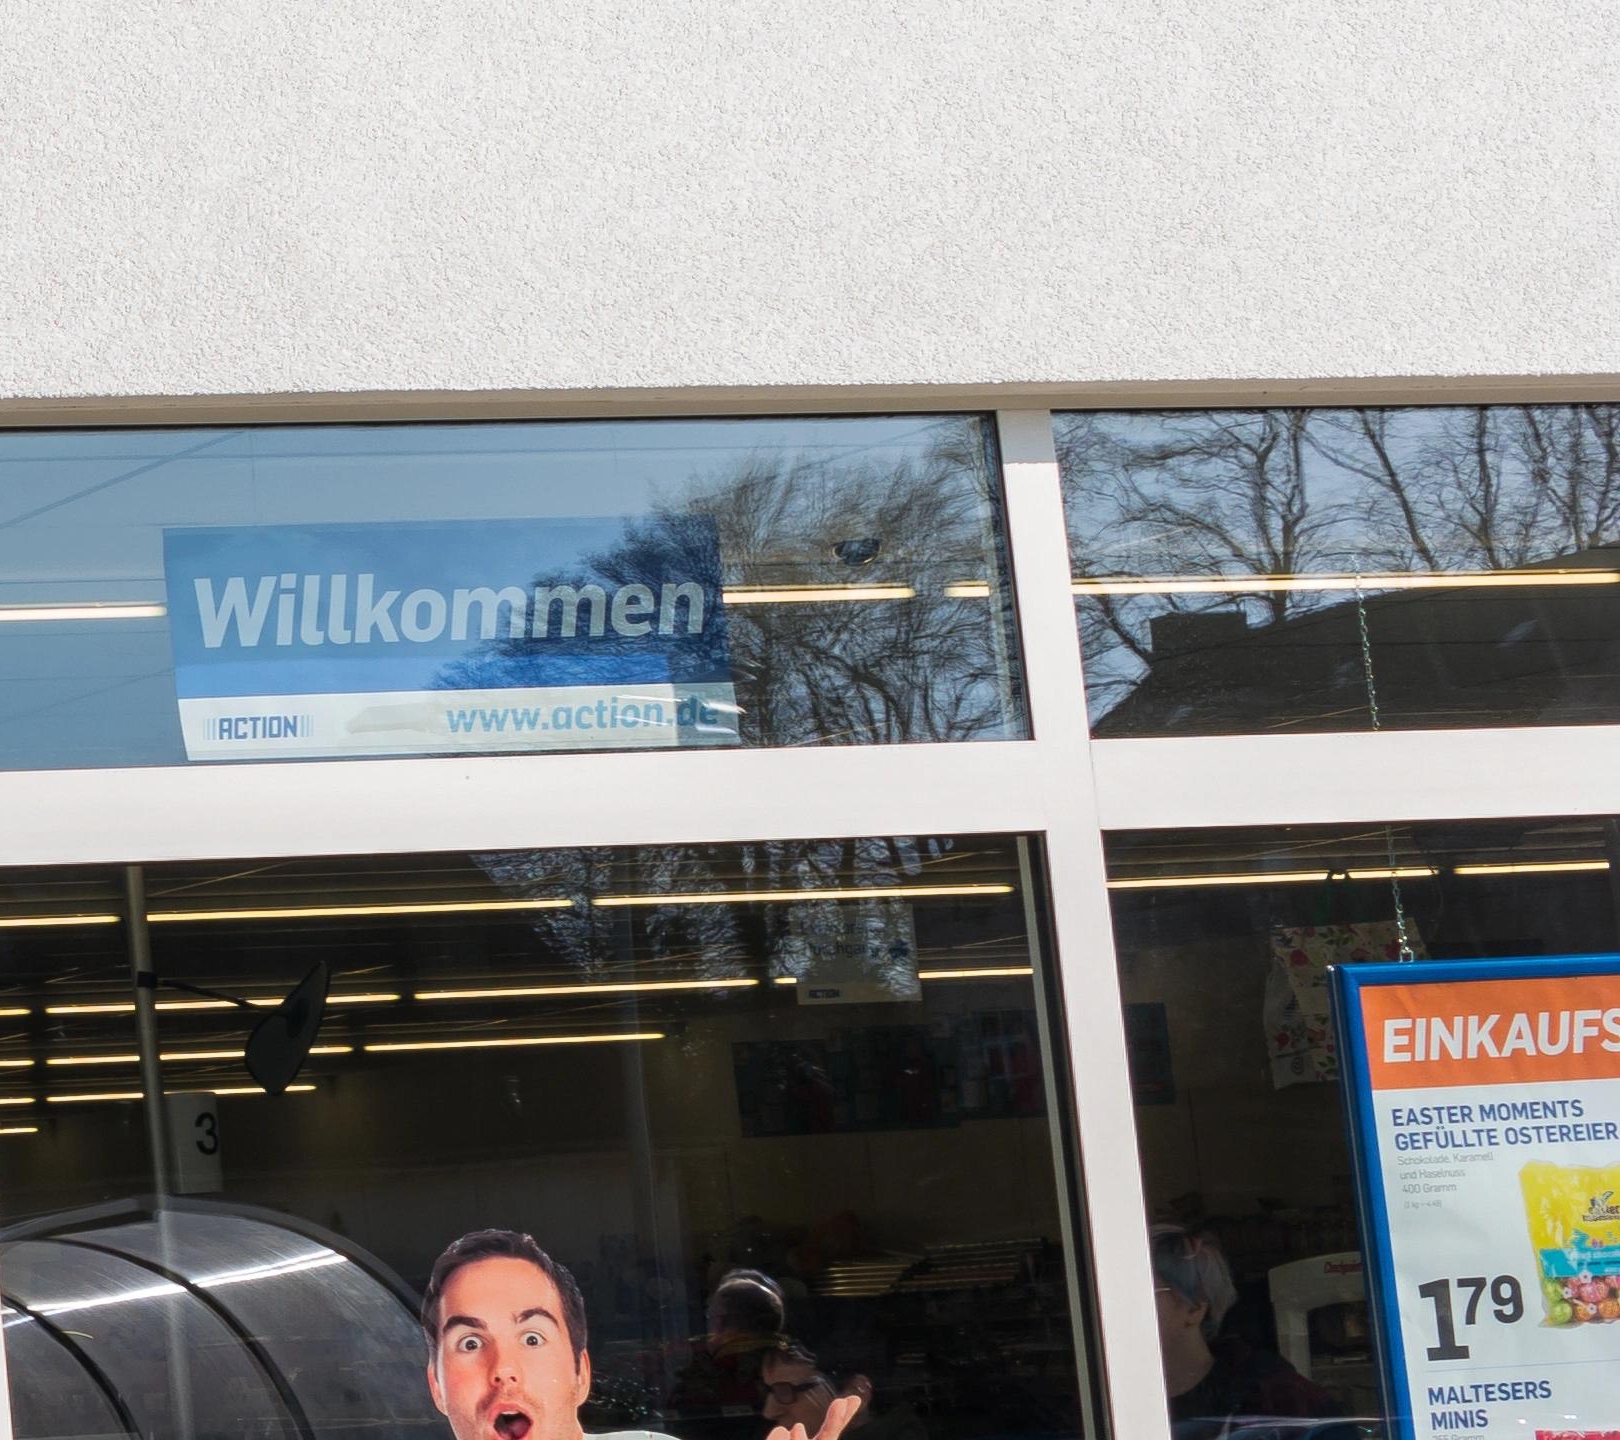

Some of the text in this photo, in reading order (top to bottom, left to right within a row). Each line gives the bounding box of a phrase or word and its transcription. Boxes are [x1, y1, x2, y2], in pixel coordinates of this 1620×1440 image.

[194, 573, 706, 649] Willkommen
[218, 715, 299, 741] ACTION
[446, 695, 720, 734] www.action.de
[1392, 1099, 1584, 1127] EASTER MOMENTS
[194, 1112, 220, 1157] 3
[1394, 1122, 1619, 1151] GEFÜLLTE OSTEREIER
[1399, 1168, 1465, 1180] und Haselnuss
[1401, 1182, 1457, 1194] 400 Gramm
[1427, 1380, 1553, 1406] MALTESERS
[1430, 1409, 1489, 1431] MINIS
